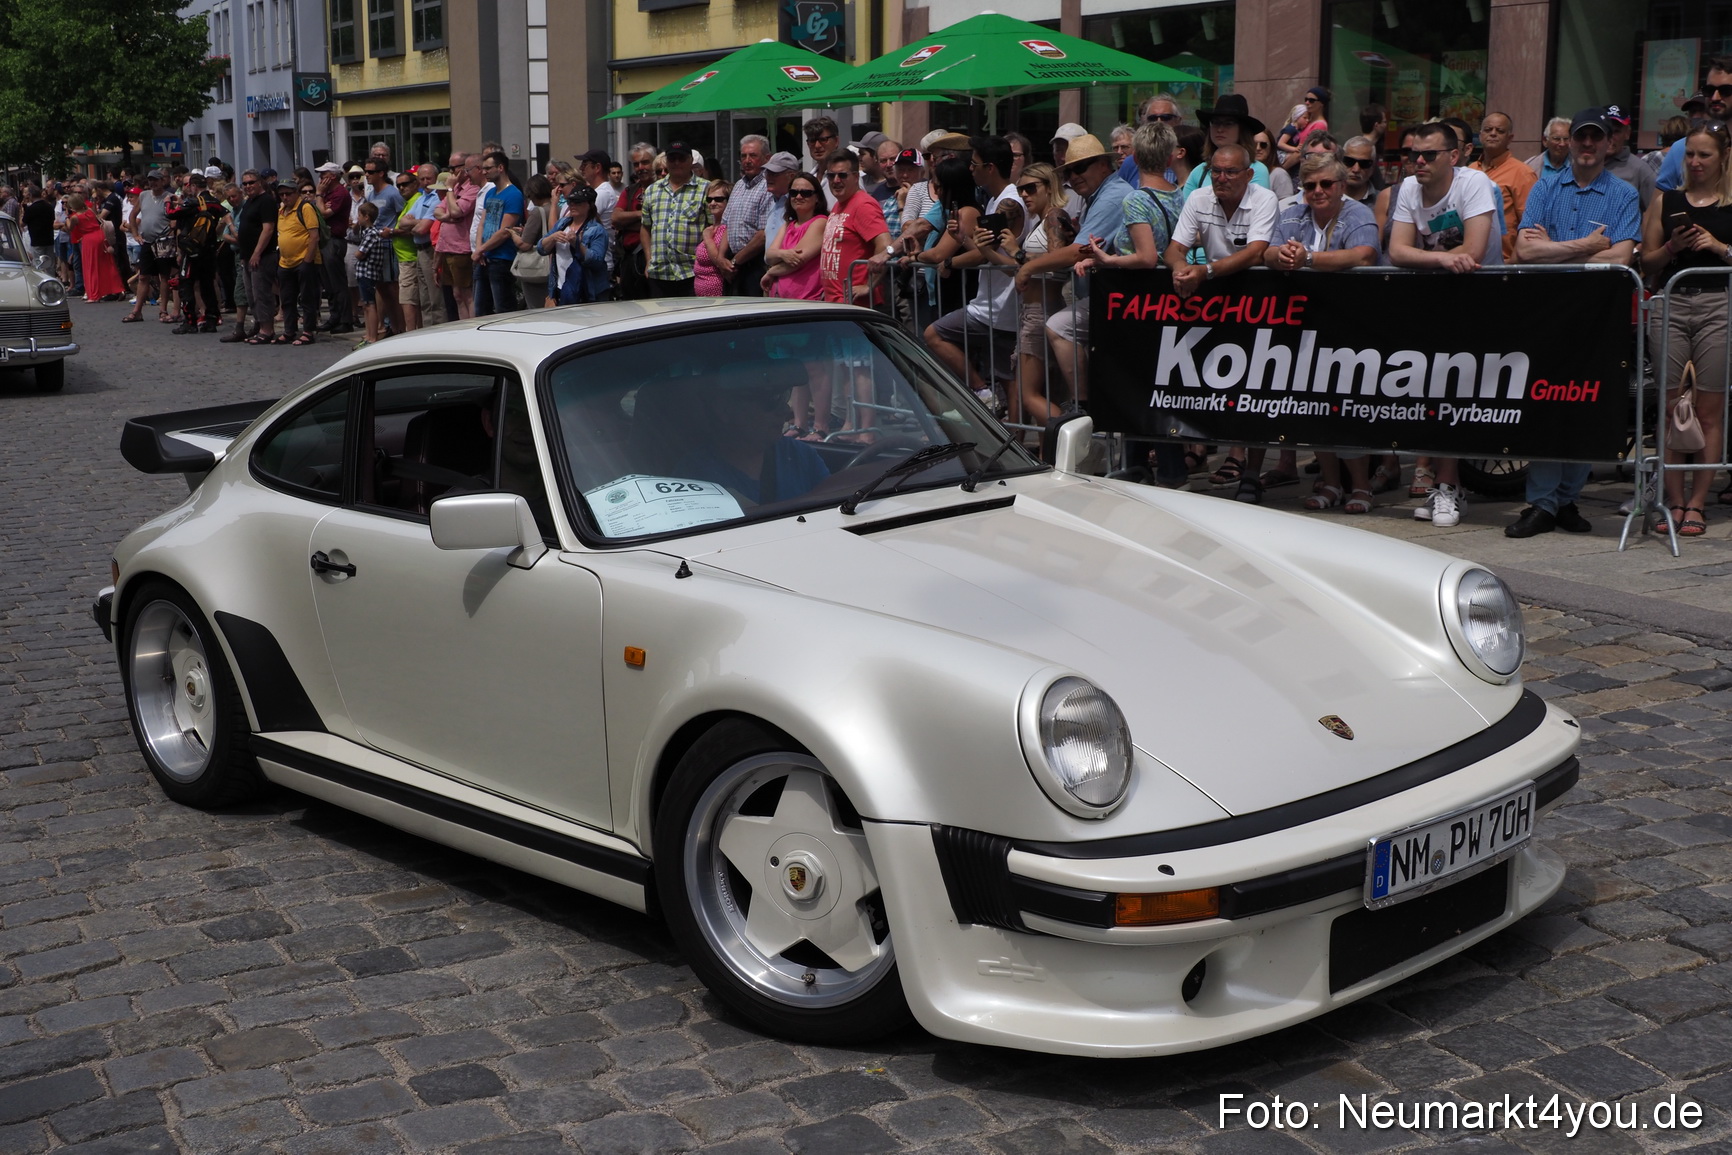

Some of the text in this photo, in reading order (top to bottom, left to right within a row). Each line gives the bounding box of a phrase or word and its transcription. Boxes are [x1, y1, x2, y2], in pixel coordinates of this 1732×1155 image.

[806, 11, 830, 41] G2
[1024, 68, 1132, 79] Lammsbräu
[307, 83, 321, 98] G2
[1107, 292, 1308, 325] FAHRSCHULE
[1154, 325, 1601, 402] Kohlmann GmbH
[1150, 389, 1522, 426] Neumarkt Burgthann Freystadt Pyrbaum
[655, 482, 704, 493] 626
[1390, 791, 1532, 887] NM PW 70H
[1376, 875, 1384, 888] D
